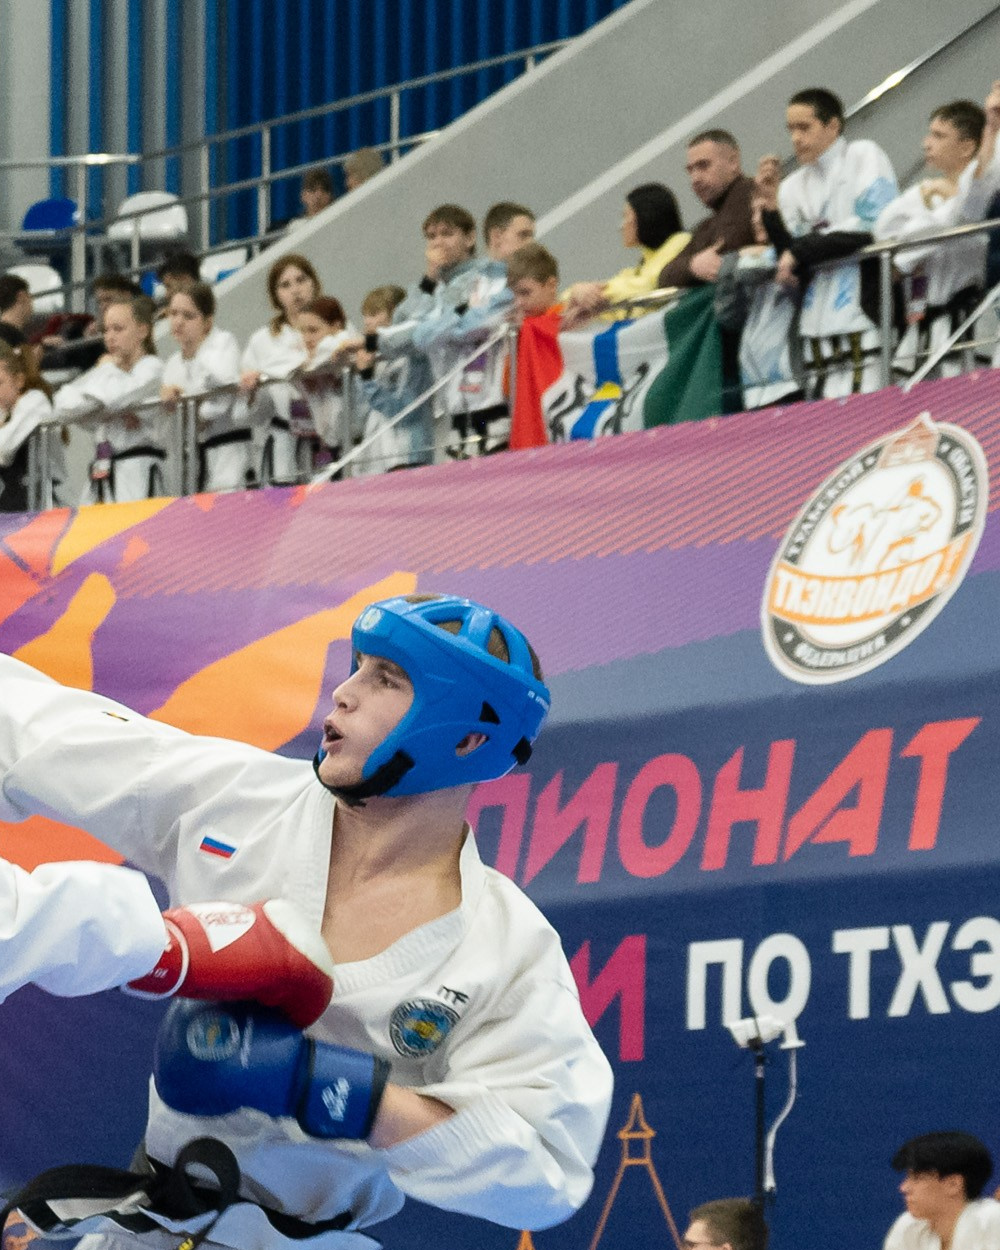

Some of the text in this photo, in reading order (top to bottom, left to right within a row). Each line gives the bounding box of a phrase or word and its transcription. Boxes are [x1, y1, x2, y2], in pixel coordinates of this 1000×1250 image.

[466, 717, 982, 887] ПИОНАТ
[687, 932, 811, 1030] ПО
[833, 916, 1000, 1020] ТХЭ
